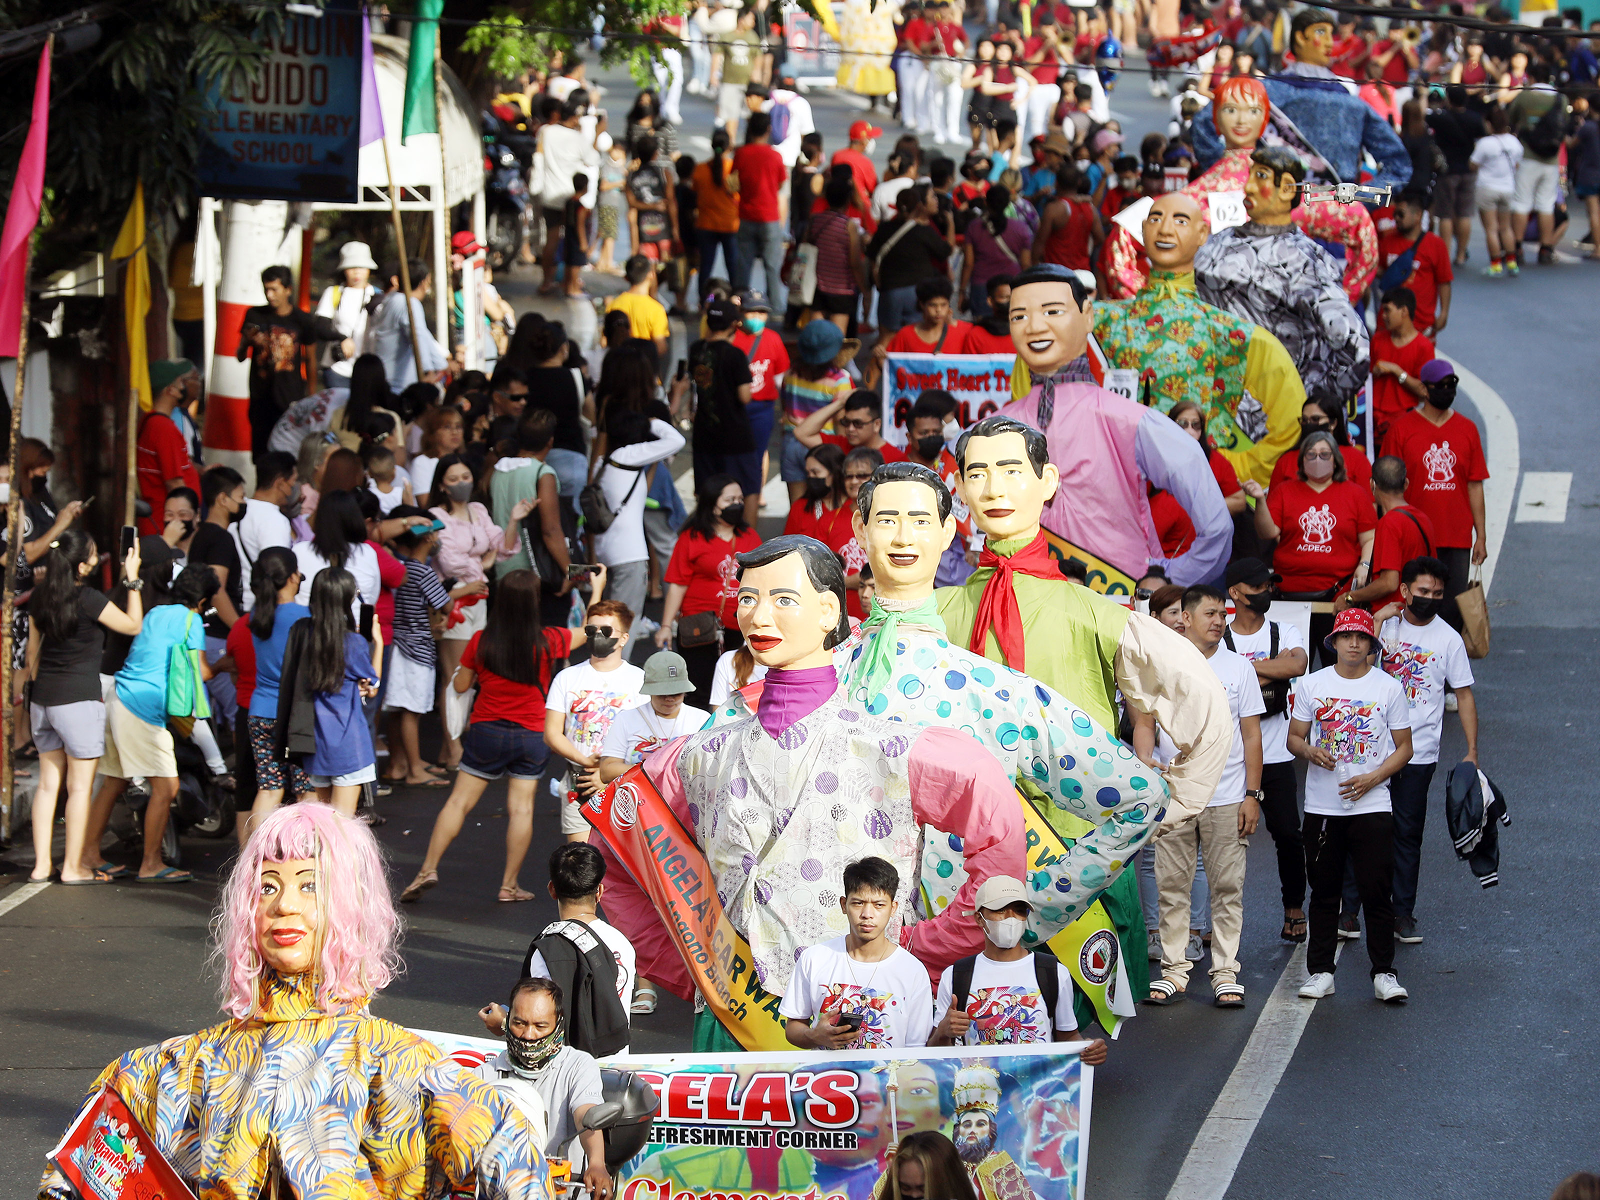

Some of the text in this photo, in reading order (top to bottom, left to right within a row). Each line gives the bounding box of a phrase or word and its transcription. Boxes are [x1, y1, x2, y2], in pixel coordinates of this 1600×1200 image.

[260, 15, 355, 57] QUIN
[209, 110, 354, 137] ELEMENTARY
[233, 140, 321, 165] SCHOOL
[1215, 202, 1240, 222] 62
[896, 366, 944, 390] Sweet
[946, 368, 991, 391] Heart
[1423, 481, 1456, 492] ACDECO
[1296, 543, 1332, 554] ACDECO
[643, 823, 788, 1030] ANGELA'S CAR WA
[703, 961, 748, 1022] Branch
[647, 1126, 858, 1149] EFRESHMENT CORNER
